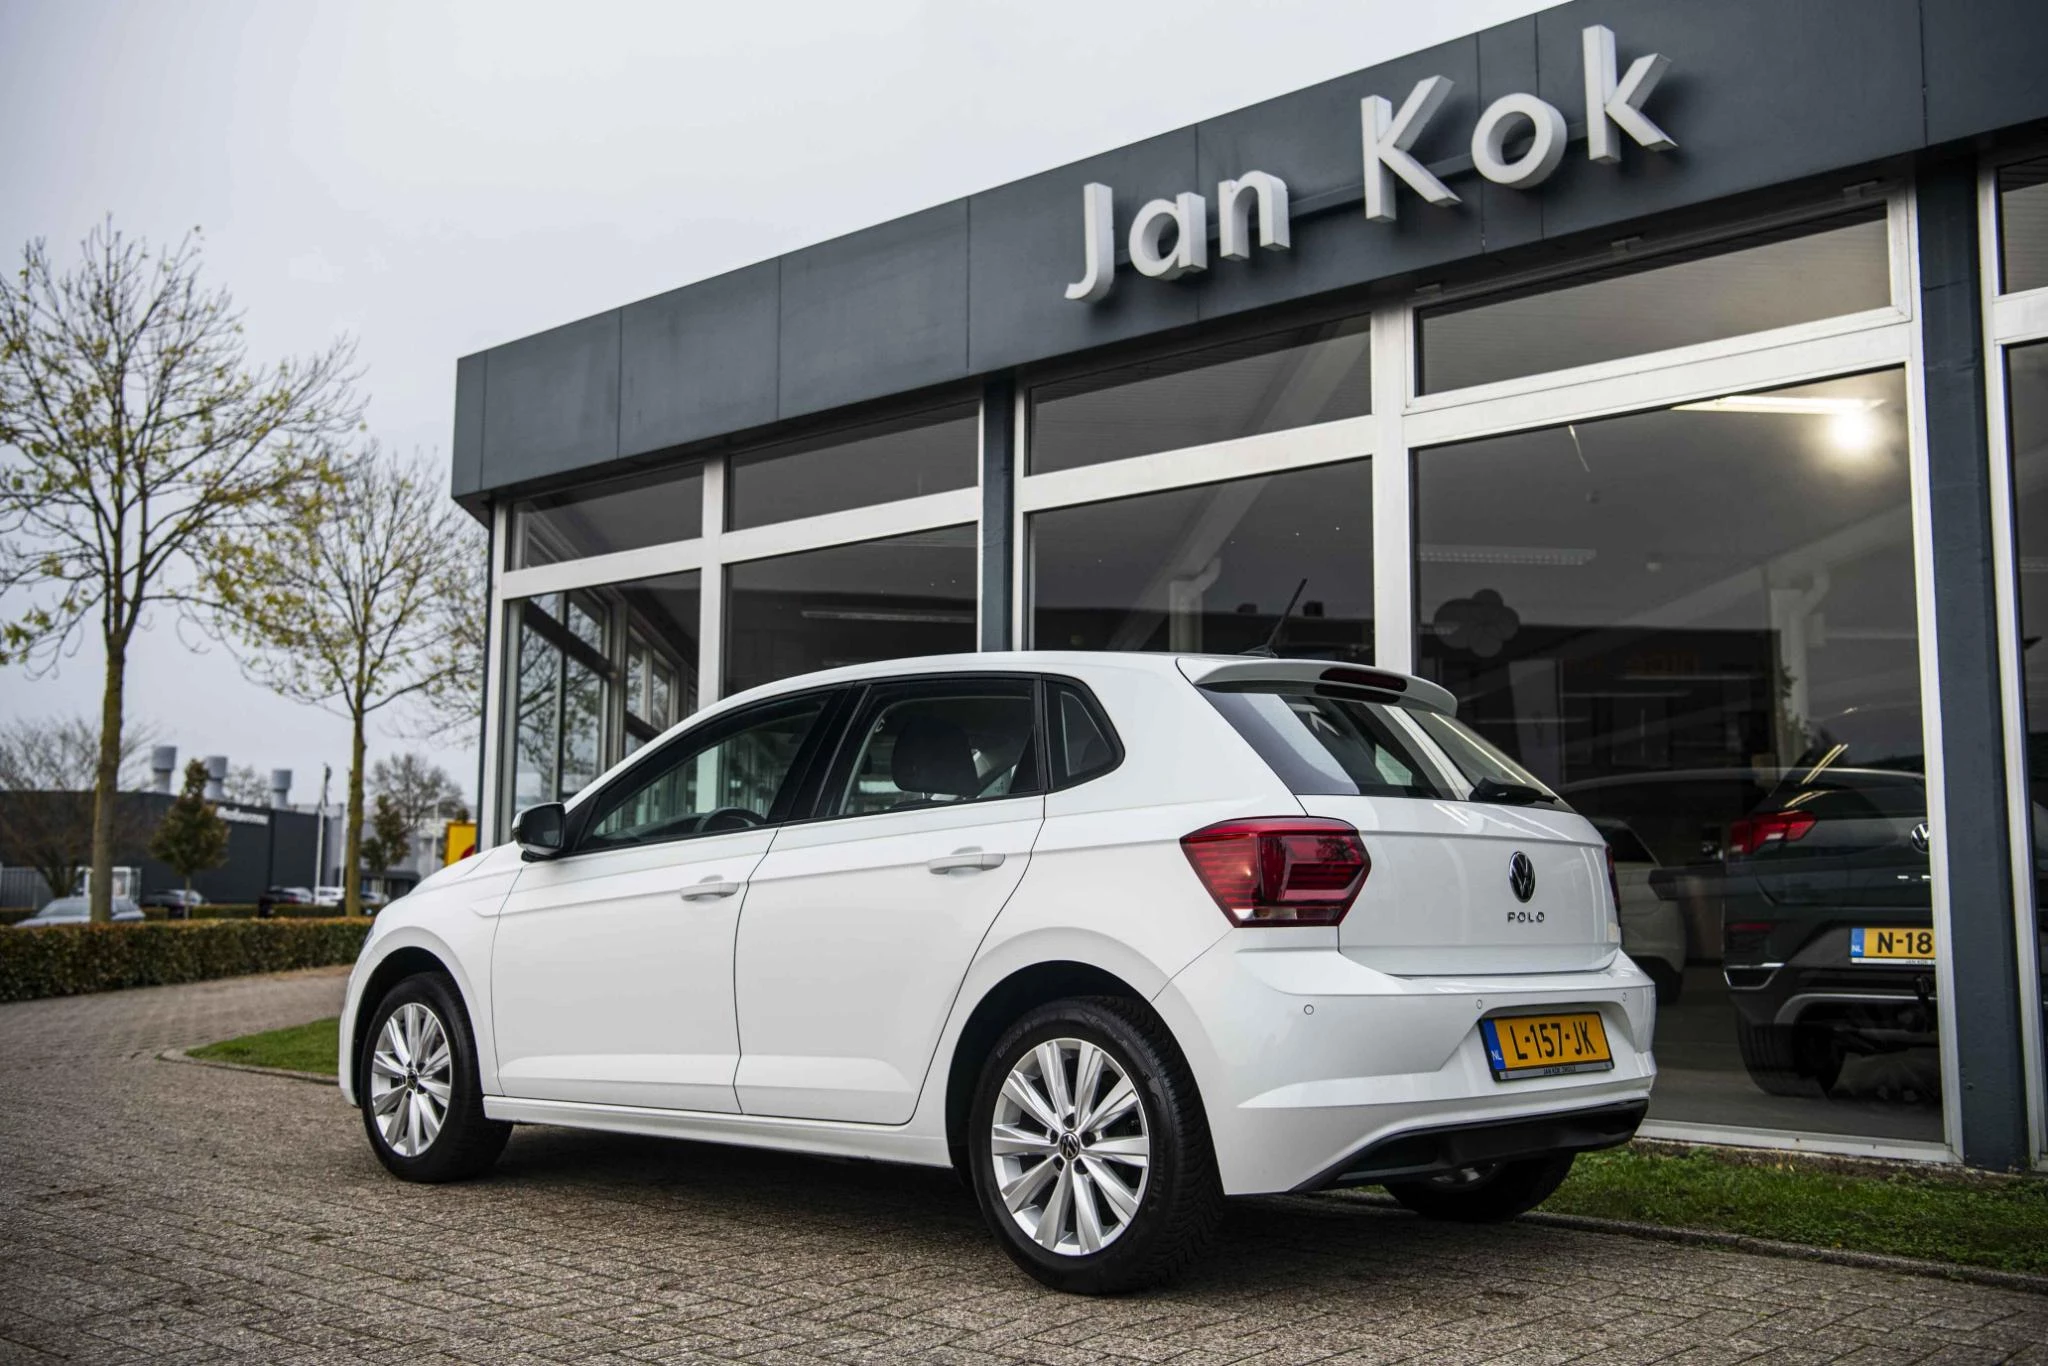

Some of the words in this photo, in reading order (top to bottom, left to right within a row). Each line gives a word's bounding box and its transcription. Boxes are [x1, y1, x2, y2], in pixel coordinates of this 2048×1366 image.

[1064, 170, 1291, 301] Jan
[1360, 24, 1678, 222] Kok
[1507, 911, 1545, 923] POLO
[1851, 945, 1862, 953] NL
[1509, 1020, 1597, 1061] L-157-JK
[1490, 1049, 1503, 1061] NL
